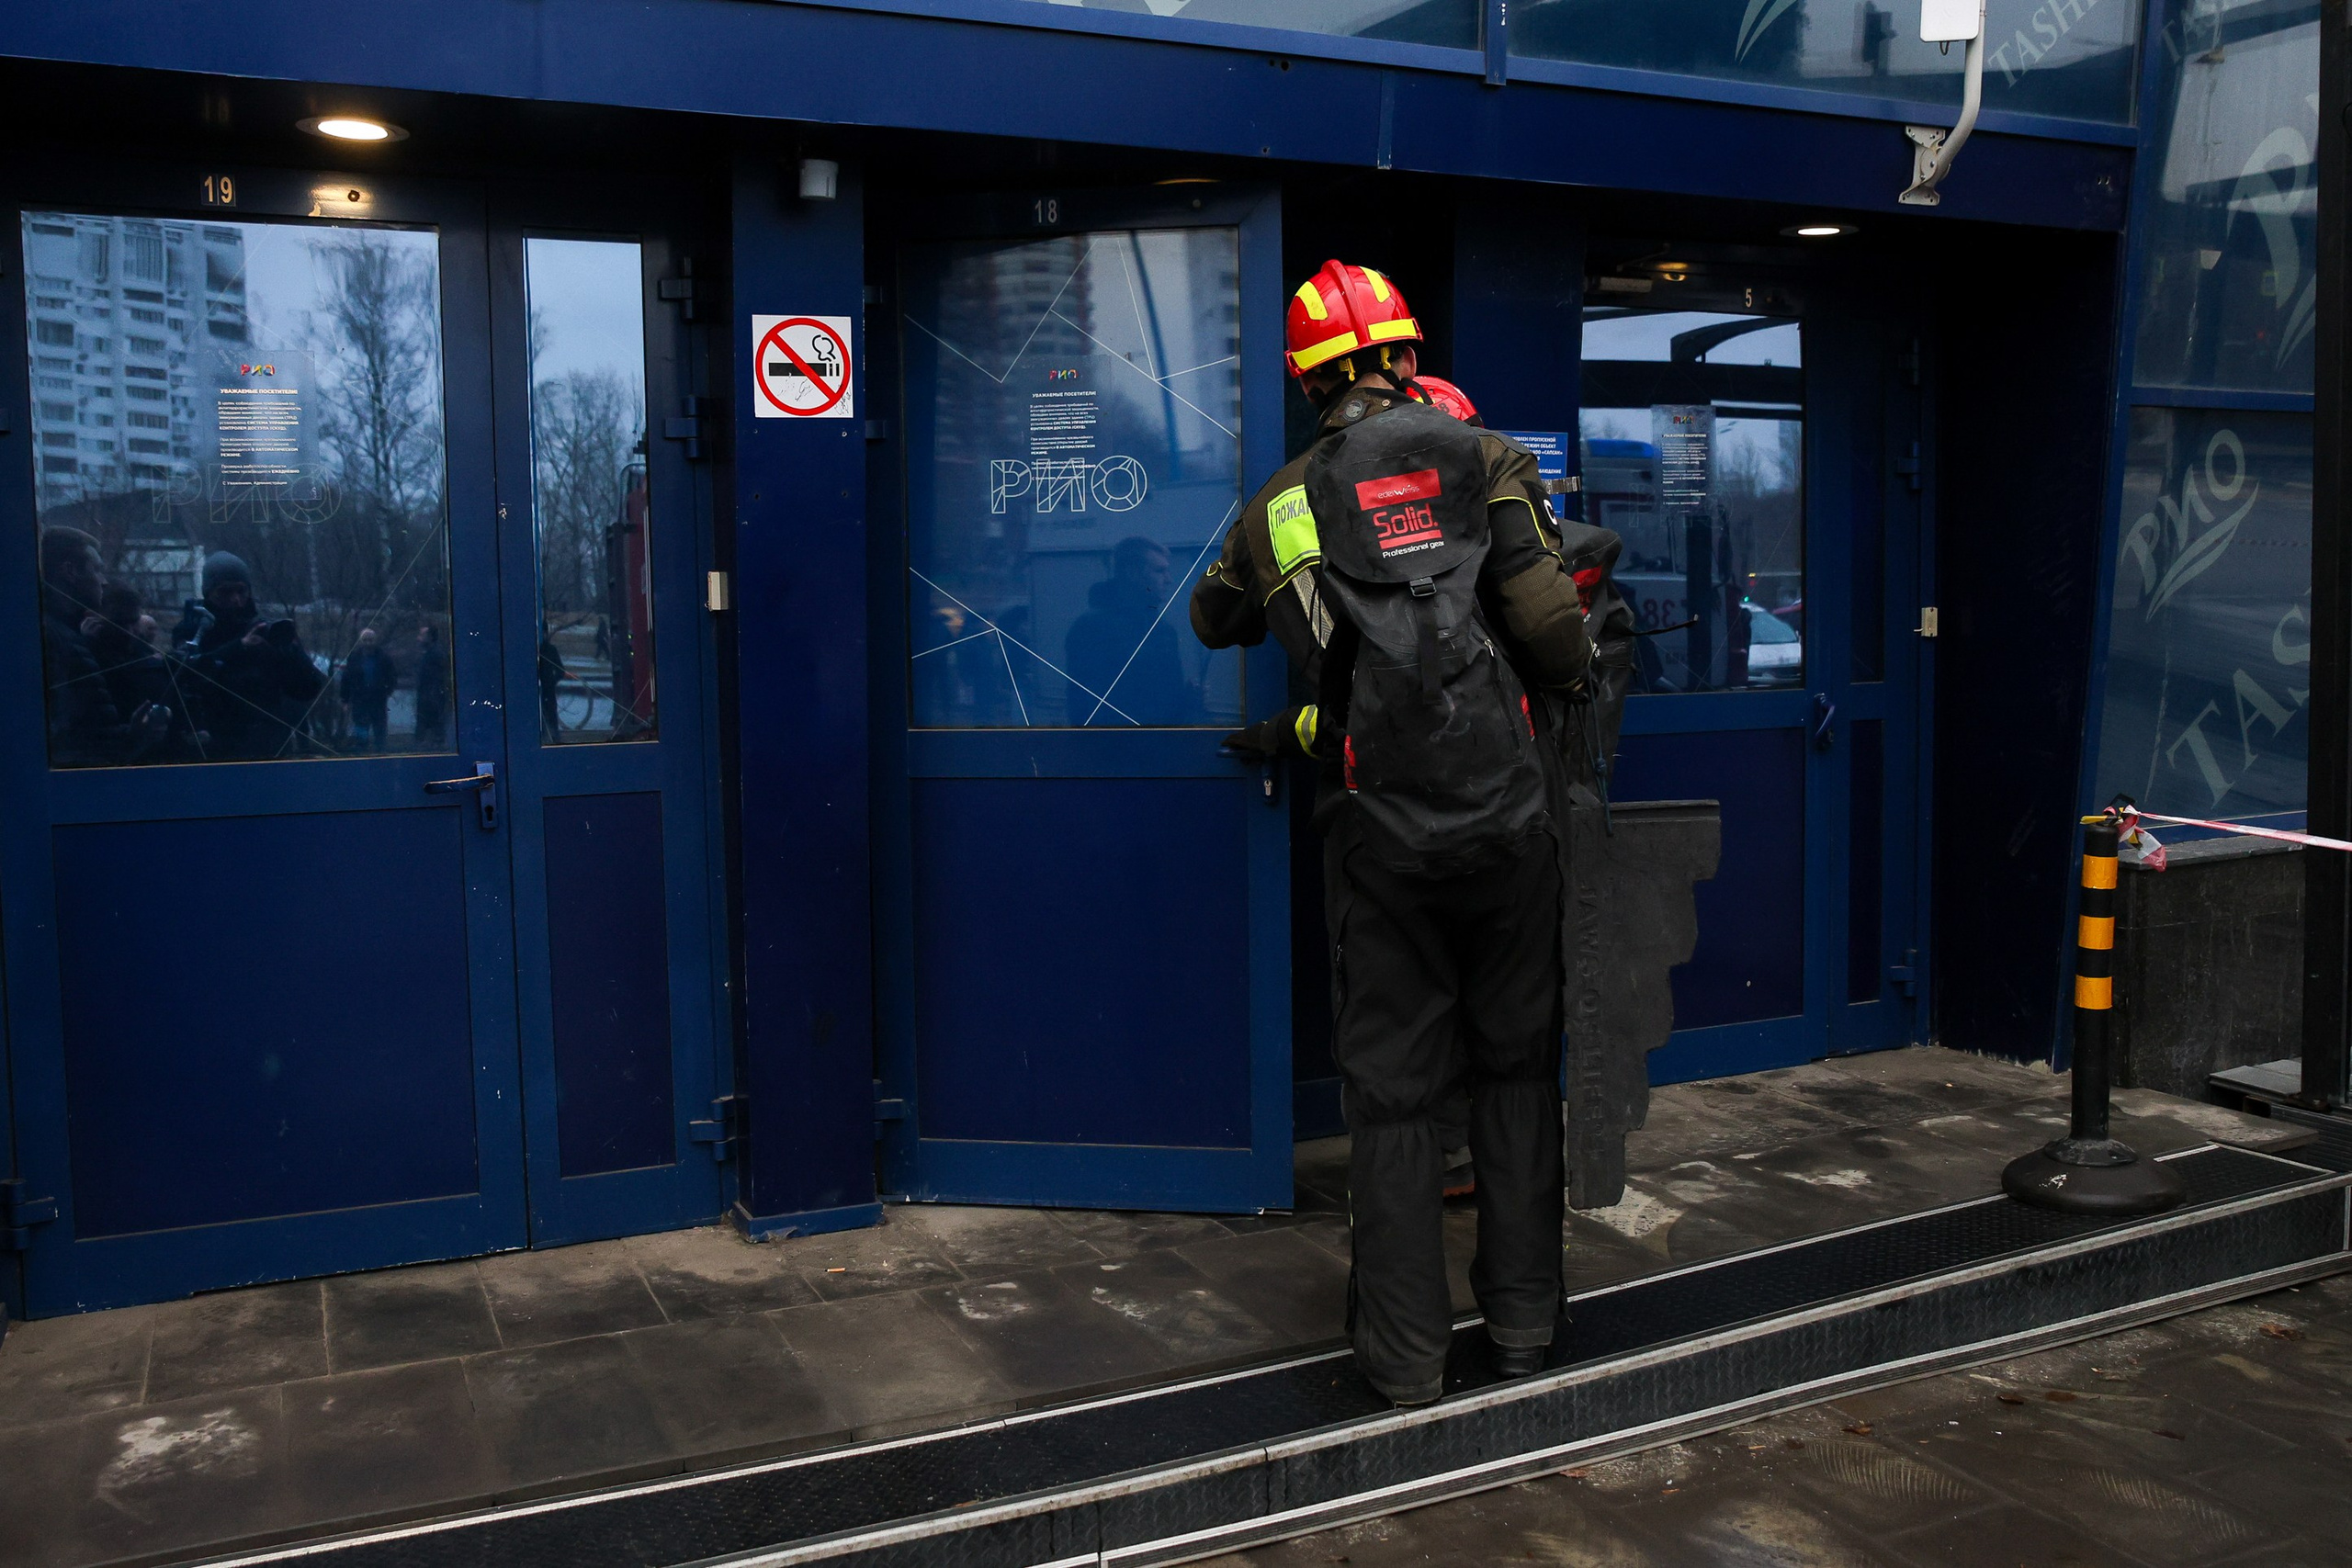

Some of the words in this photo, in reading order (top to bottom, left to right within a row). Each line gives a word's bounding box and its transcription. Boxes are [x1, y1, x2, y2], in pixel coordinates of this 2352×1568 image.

[1987, 0, 2095, 88] TASH
[204, 175, 232, 204] 19
[1035, 199, 1057, 223] 18
[1745, 288, 1752, 308] 5
[990, 455, 1148, 513] РИО
[2120, 429, 2245, 595] РИО
[1382, 543, 1429, 558] Professional
[1429, 541, 1445, 549] gear
[2165, 588, 2312, 809] TAS
